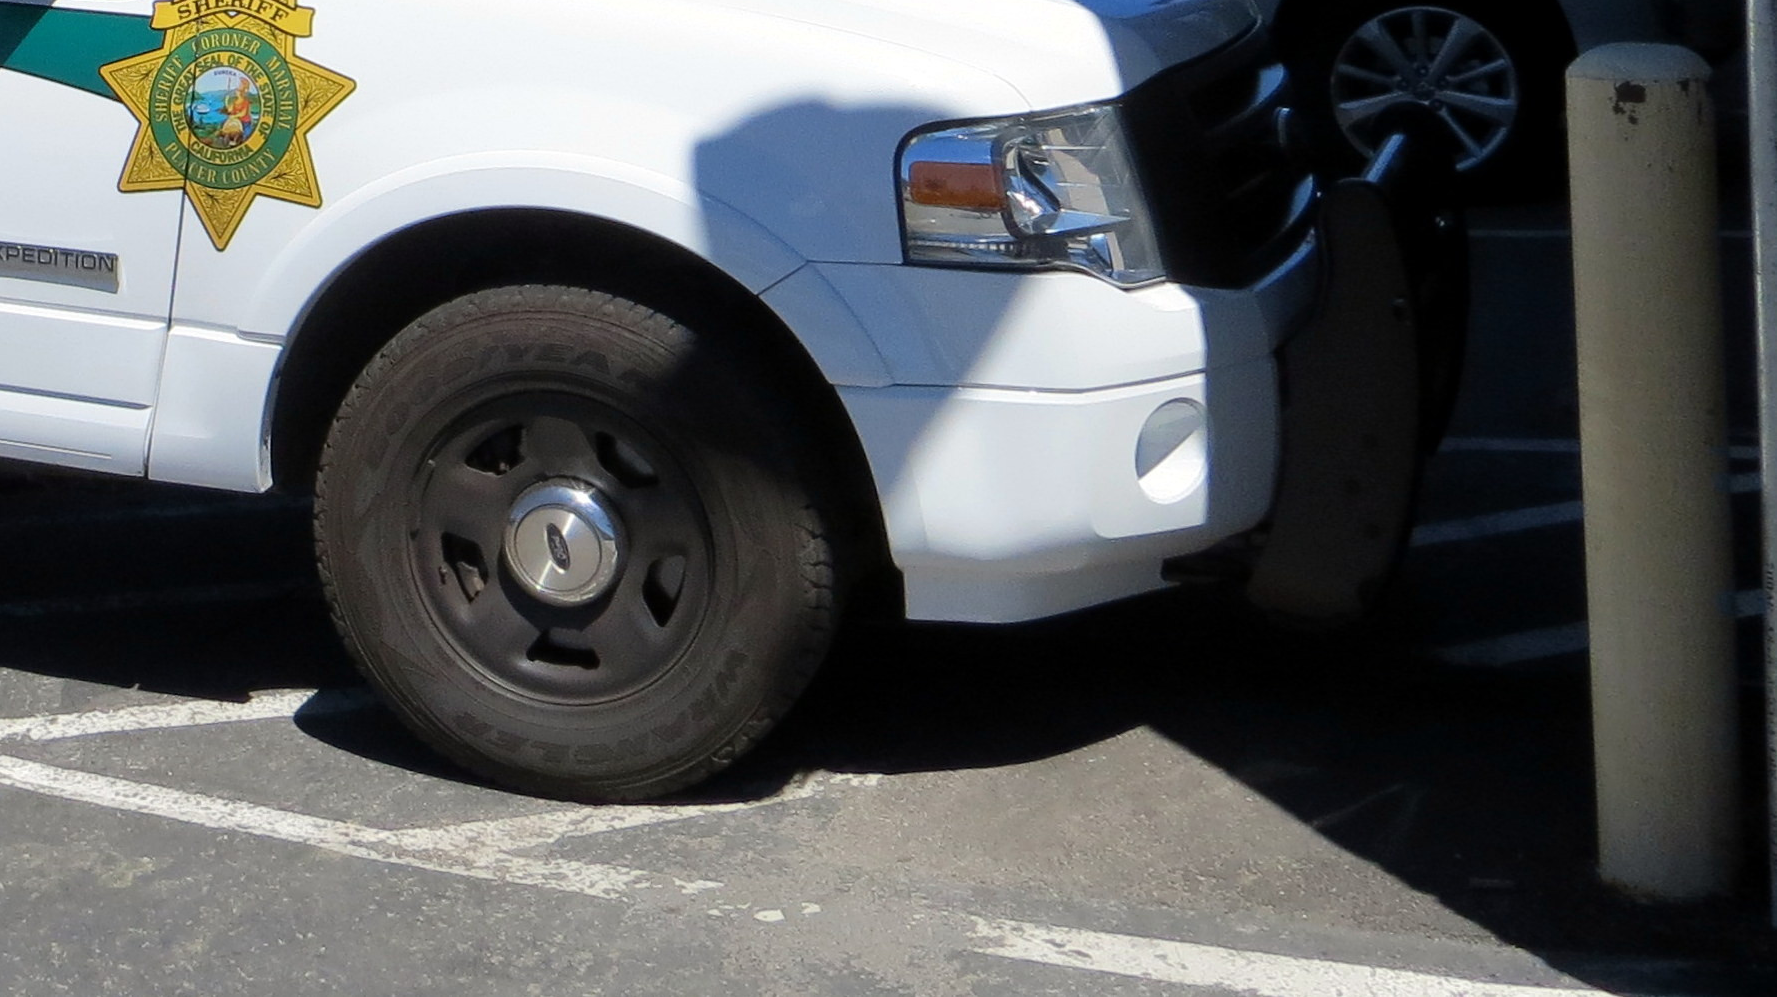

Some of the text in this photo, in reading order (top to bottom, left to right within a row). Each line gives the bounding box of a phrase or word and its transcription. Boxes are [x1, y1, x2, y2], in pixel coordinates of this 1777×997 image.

[197, 53, 222, 71] SEAL
[227, 54, 244, 66] OF
[243, 60, 263, 82] THE
[155, 33, 294, 130] SHERIFF CORONER MARSHAL
[260, 81, 275, 118] STATE
[172, 110, 188, 135] THE
[257, 121, 272, 139] OF
[165, 142, 276, 184] PLACER COUNTY
